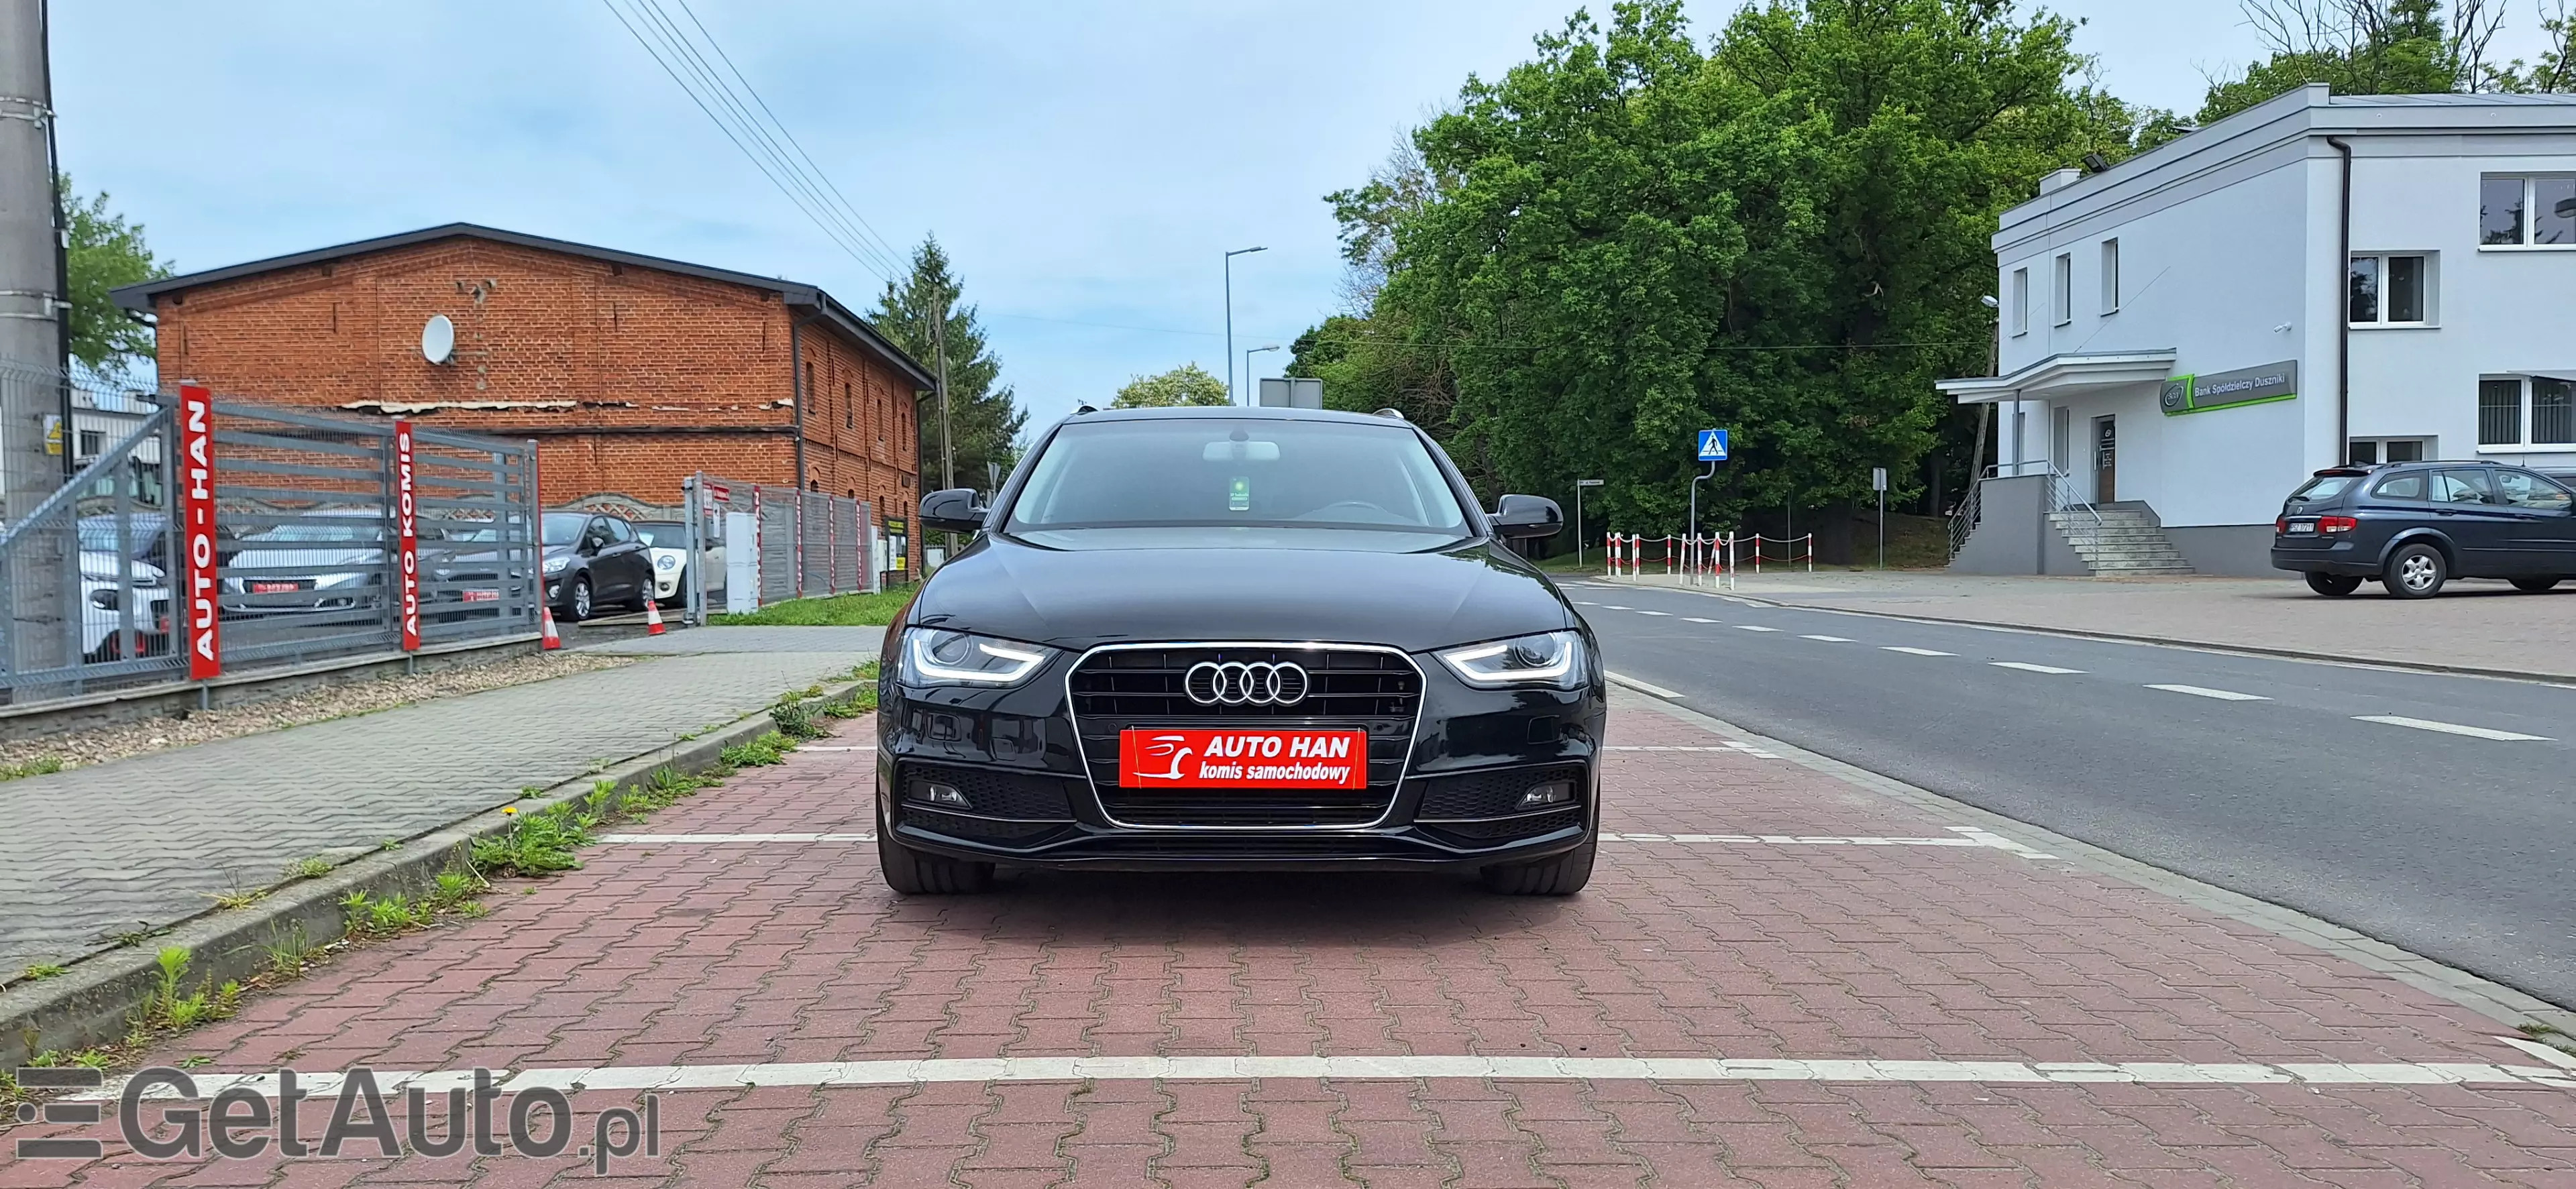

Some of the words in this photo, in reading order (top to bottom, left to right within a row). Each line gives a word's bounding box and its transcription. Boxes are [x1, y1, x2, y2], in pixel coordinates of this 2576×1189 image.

[2194, 386, 2211, 398] Bank
[2212, 379, 2253, 396] Spółdzielczy
[2255, 373, 2285, 388] Duszniki
[188, 400, 209, 500] HAN
[399, 432, 413, 537] KOMIS
[193, 533, 213, 661] AUTO
[404, 550, 417, 636] AUTO
[1199, 760, 1243, 779] komis
[1246, 762, 1350, 785] samochodowy
[1203, 736, 1282, 758] AUTO
[1289, 736, 1351, 758] HAN
